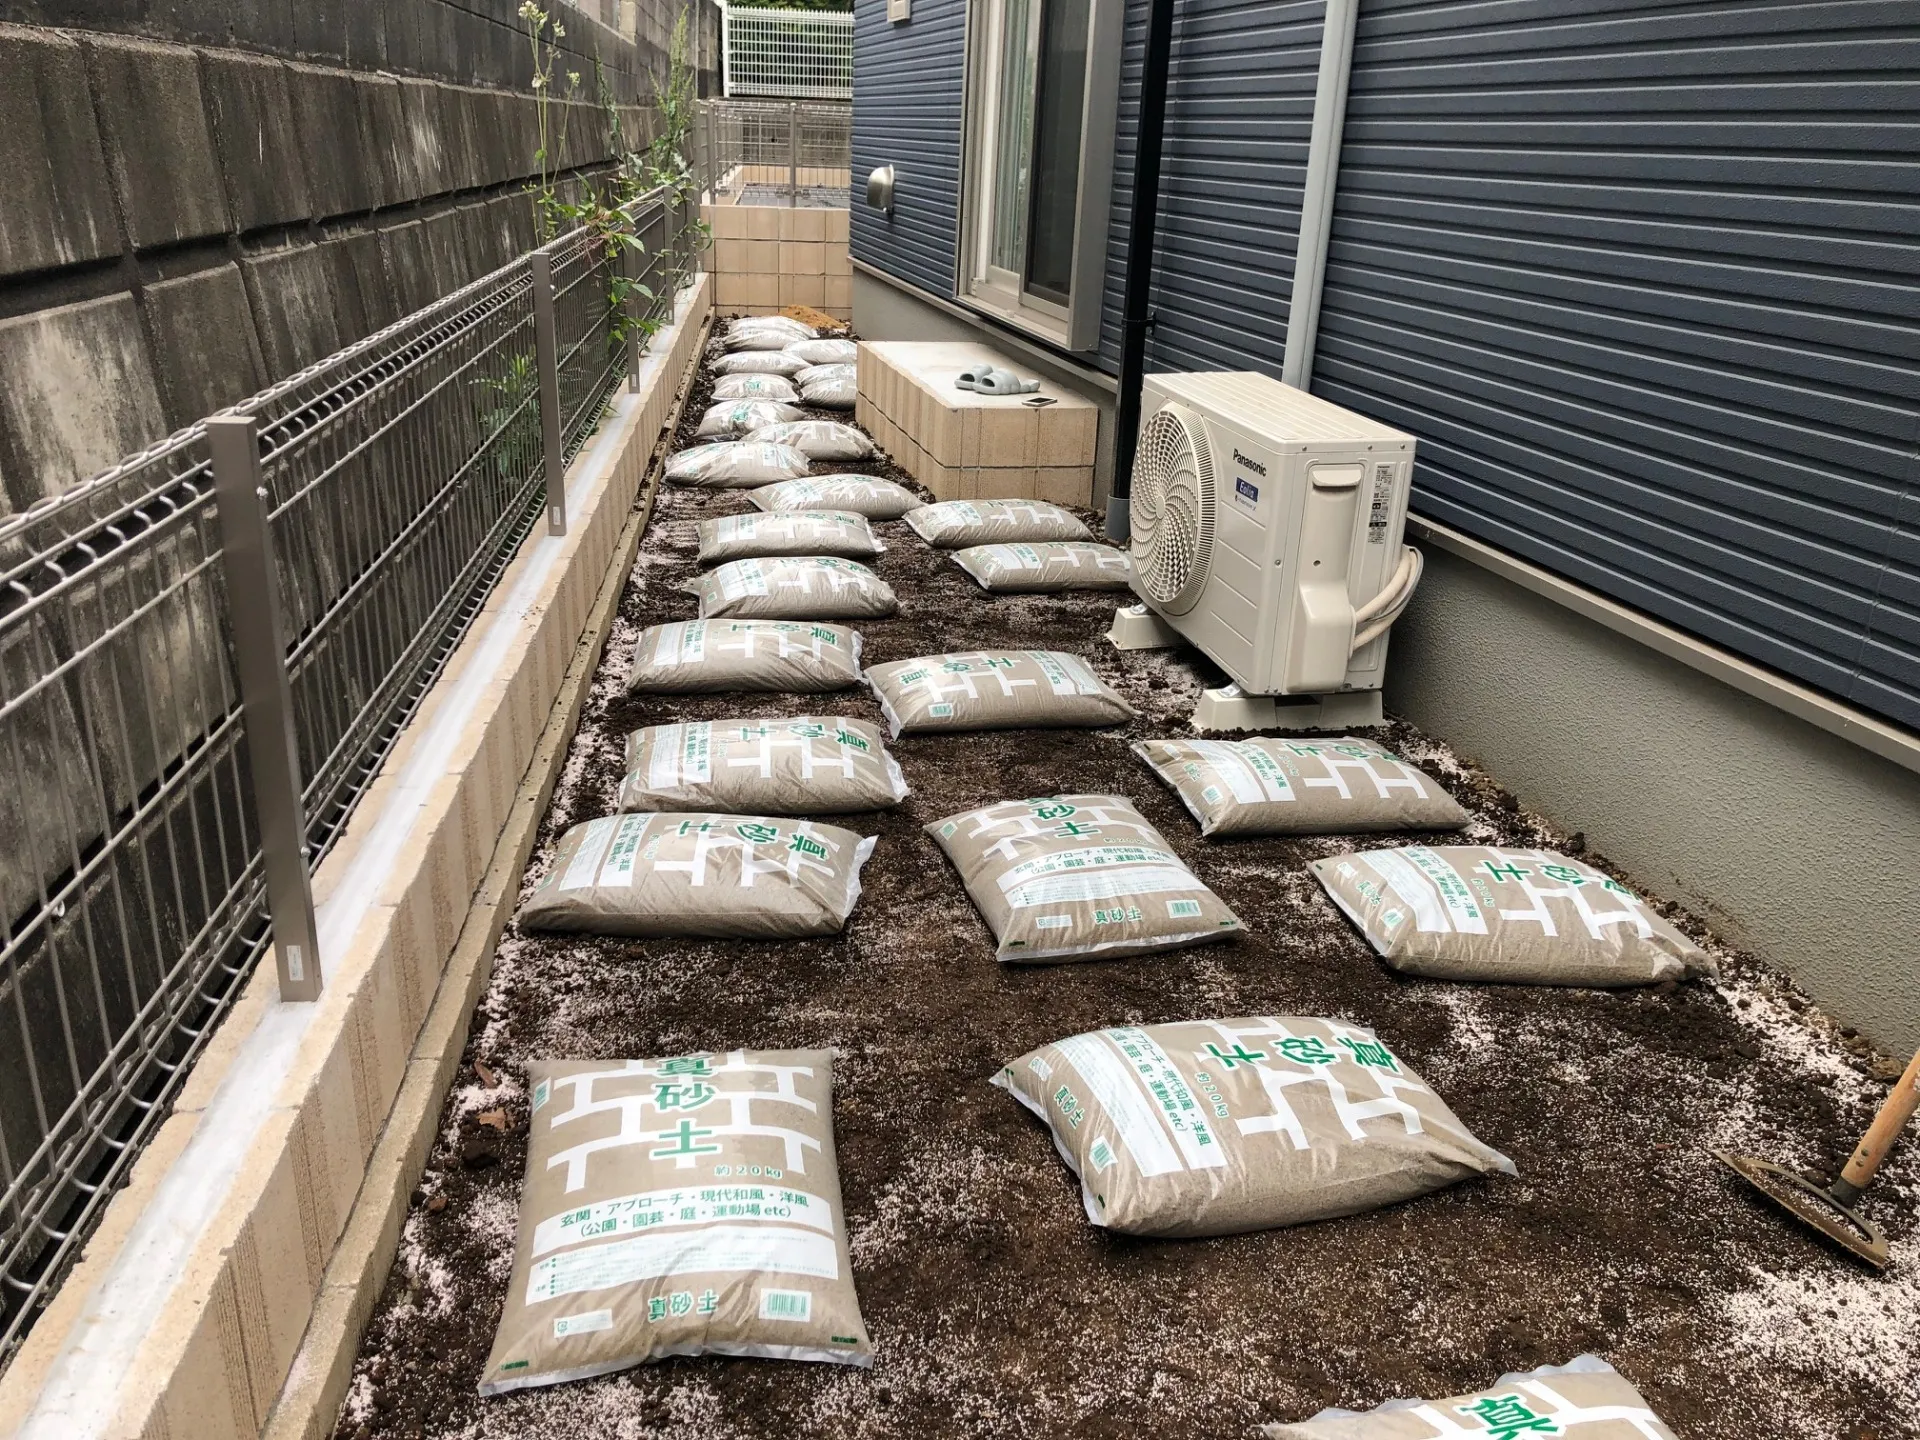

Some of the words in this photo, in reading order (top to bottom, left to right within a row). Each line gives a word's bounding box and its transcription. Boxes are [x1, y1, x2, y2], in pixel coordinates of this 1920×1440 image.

[1232, 447, 1267, 477] Panasonic
[679, 820, 828, 860] 真砂土
[1095, 906, 1142, 923] 真砂土
[1205, 1036, 1399, 1073] 真砂土
[653, 1055, 719, 1158] 真砂土
[648, 1290, 718, 1321] 真砂土
